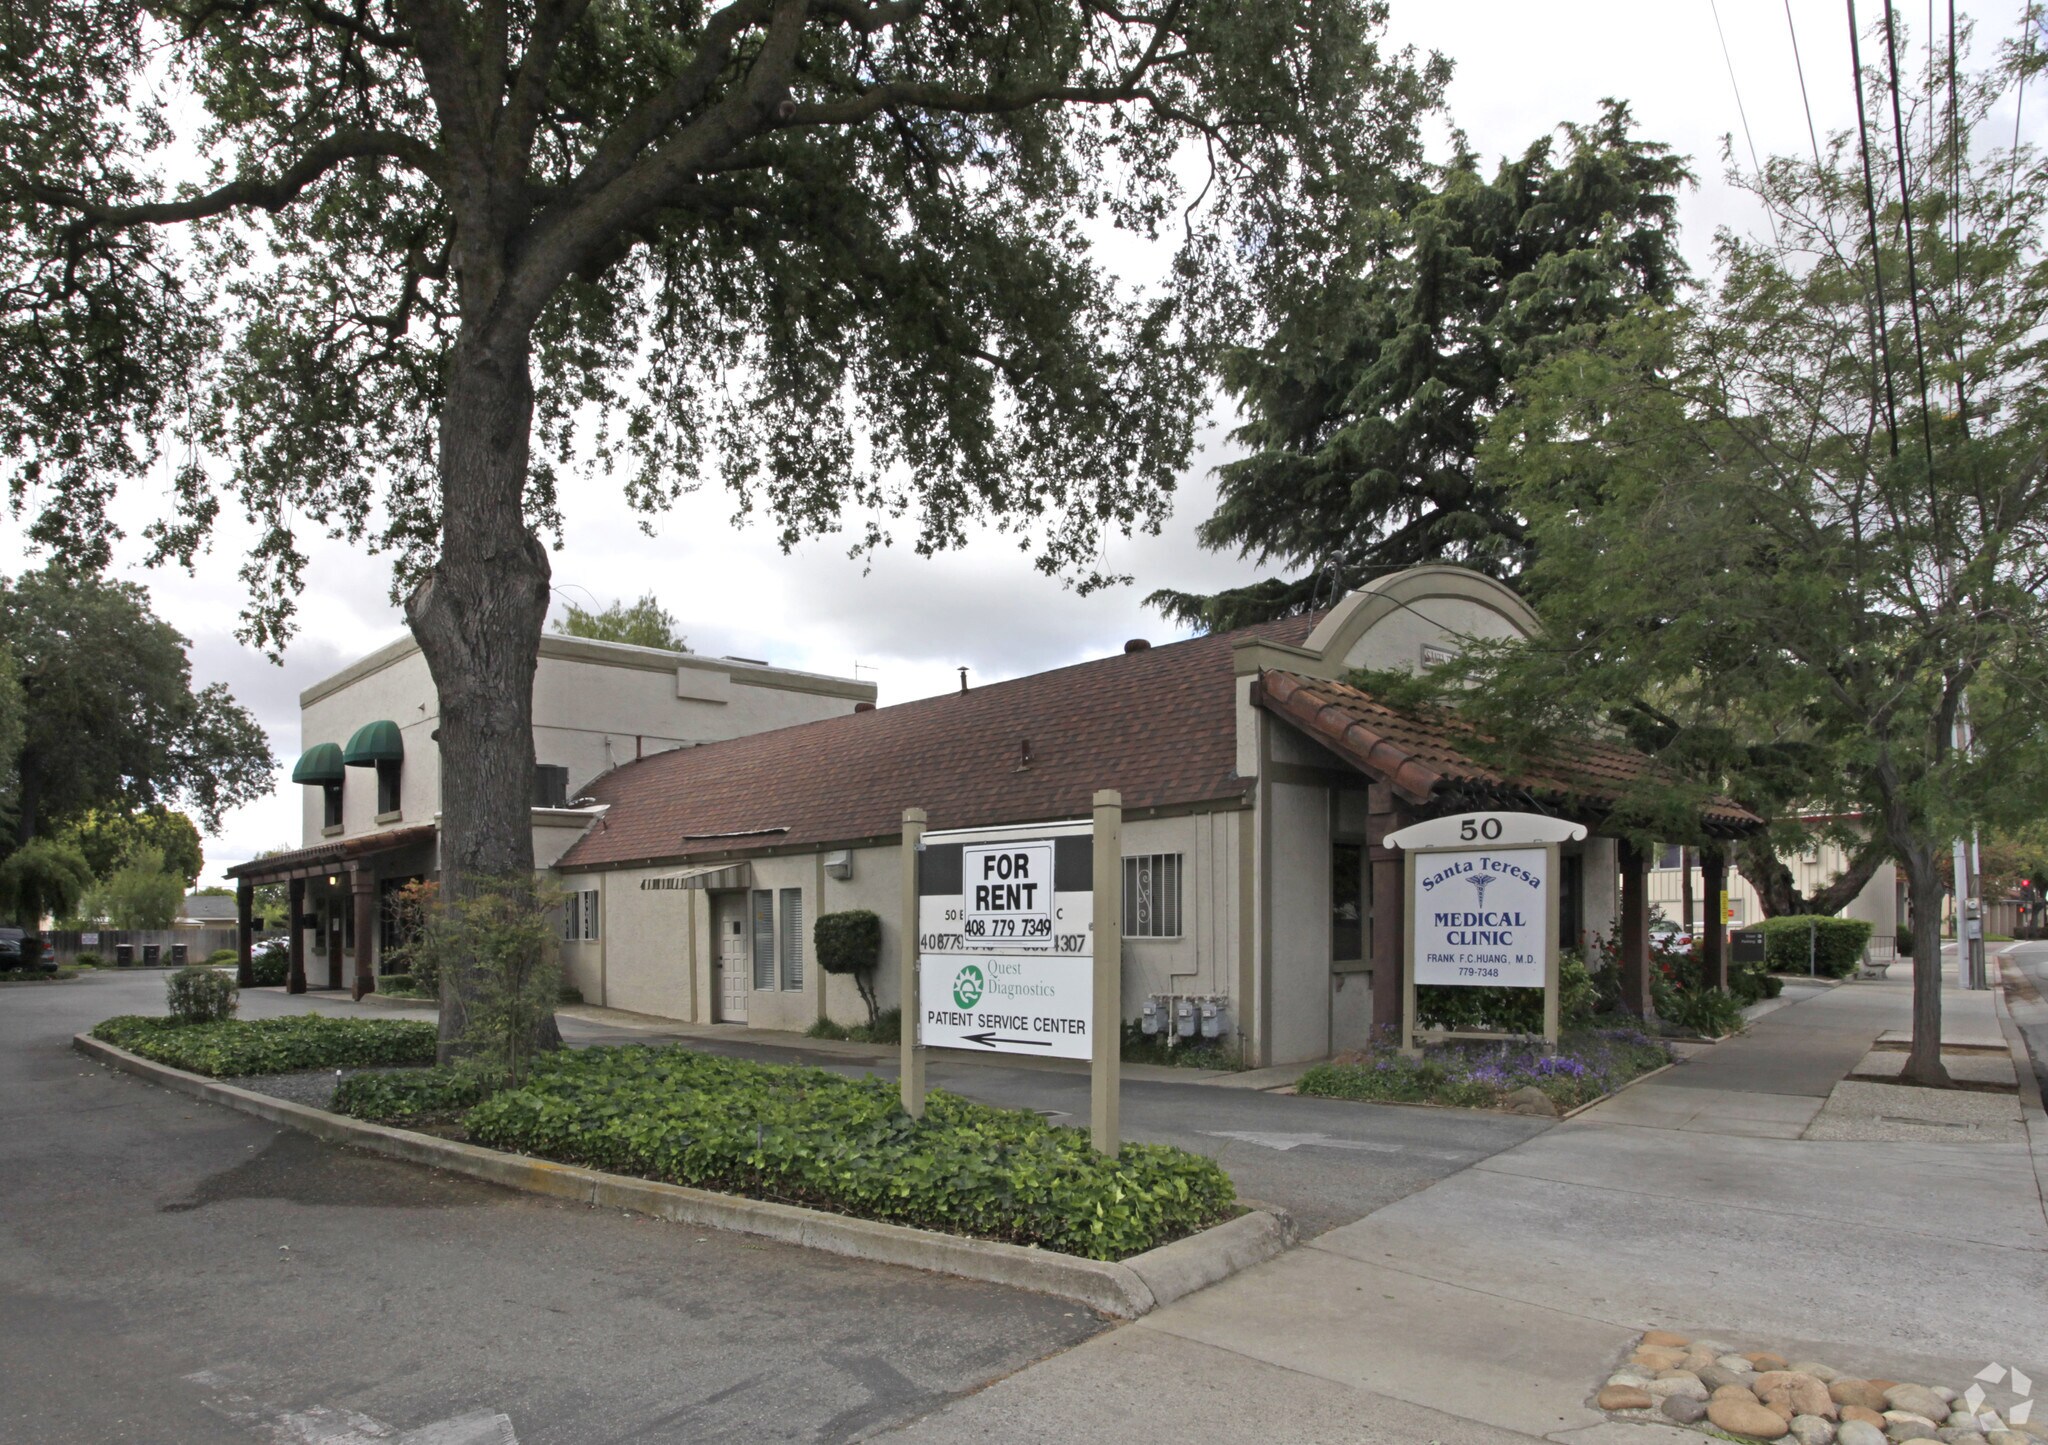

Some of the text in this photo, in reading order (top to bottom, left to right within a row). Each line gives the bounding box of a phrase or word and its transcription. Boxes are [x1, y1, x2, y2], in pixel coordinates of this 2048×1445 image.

[1460, 817, 1502, 841] 50
[984, 853, 1029, 880] FOR
[1422, 857, 1541, 892] Santa Teresa
[976, 883, 1038, 911] RENT
[945, 909, 956, 920] 50
[1434, 912, 1526, 927] MEDICAL
[965, 918, 1052, 936] 408 779 7349
[1446, 931, 1513, 946] CLINIC
[1427, 953, 1455, 964] FRANK
[1515, 954, 1537, 964] M.D.
[987, 959, 1022, 978] Quest
[1459, 967, 1499, 978] 779-7348
[988, 979, 1055, 1000] Diagnostics
[928, 1011, 1086, 1035] PATIENT SERVICE CENTER
